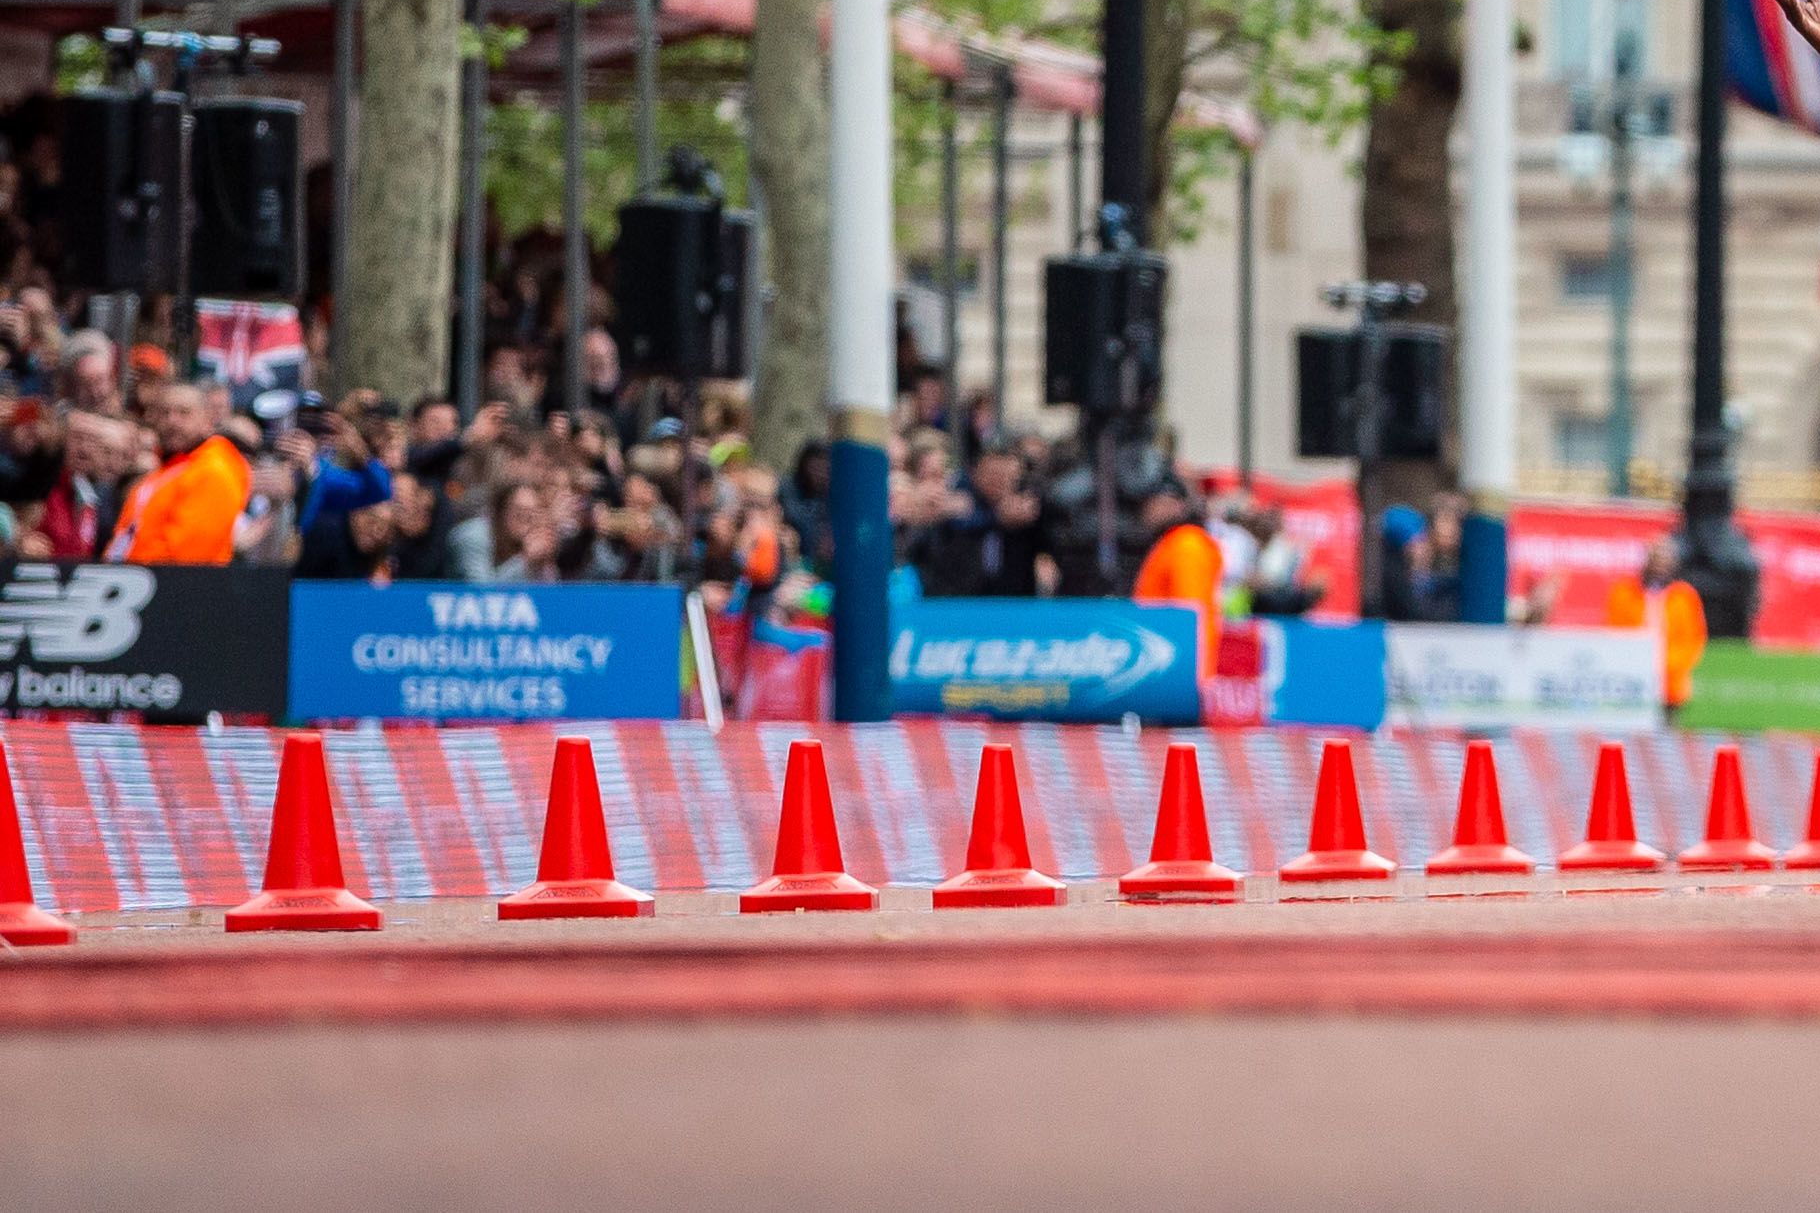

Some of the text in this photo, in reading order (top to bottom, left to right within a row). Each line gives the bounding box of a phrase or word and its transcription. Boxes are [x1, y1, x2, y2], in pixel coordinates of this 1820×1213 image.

[428, 592, 539, 629] TATA
[352, 633, 612, 673] CONSULTANCY
[17, 664, 183, 709] balance
[401, 675, 567, 713] SERVICES
